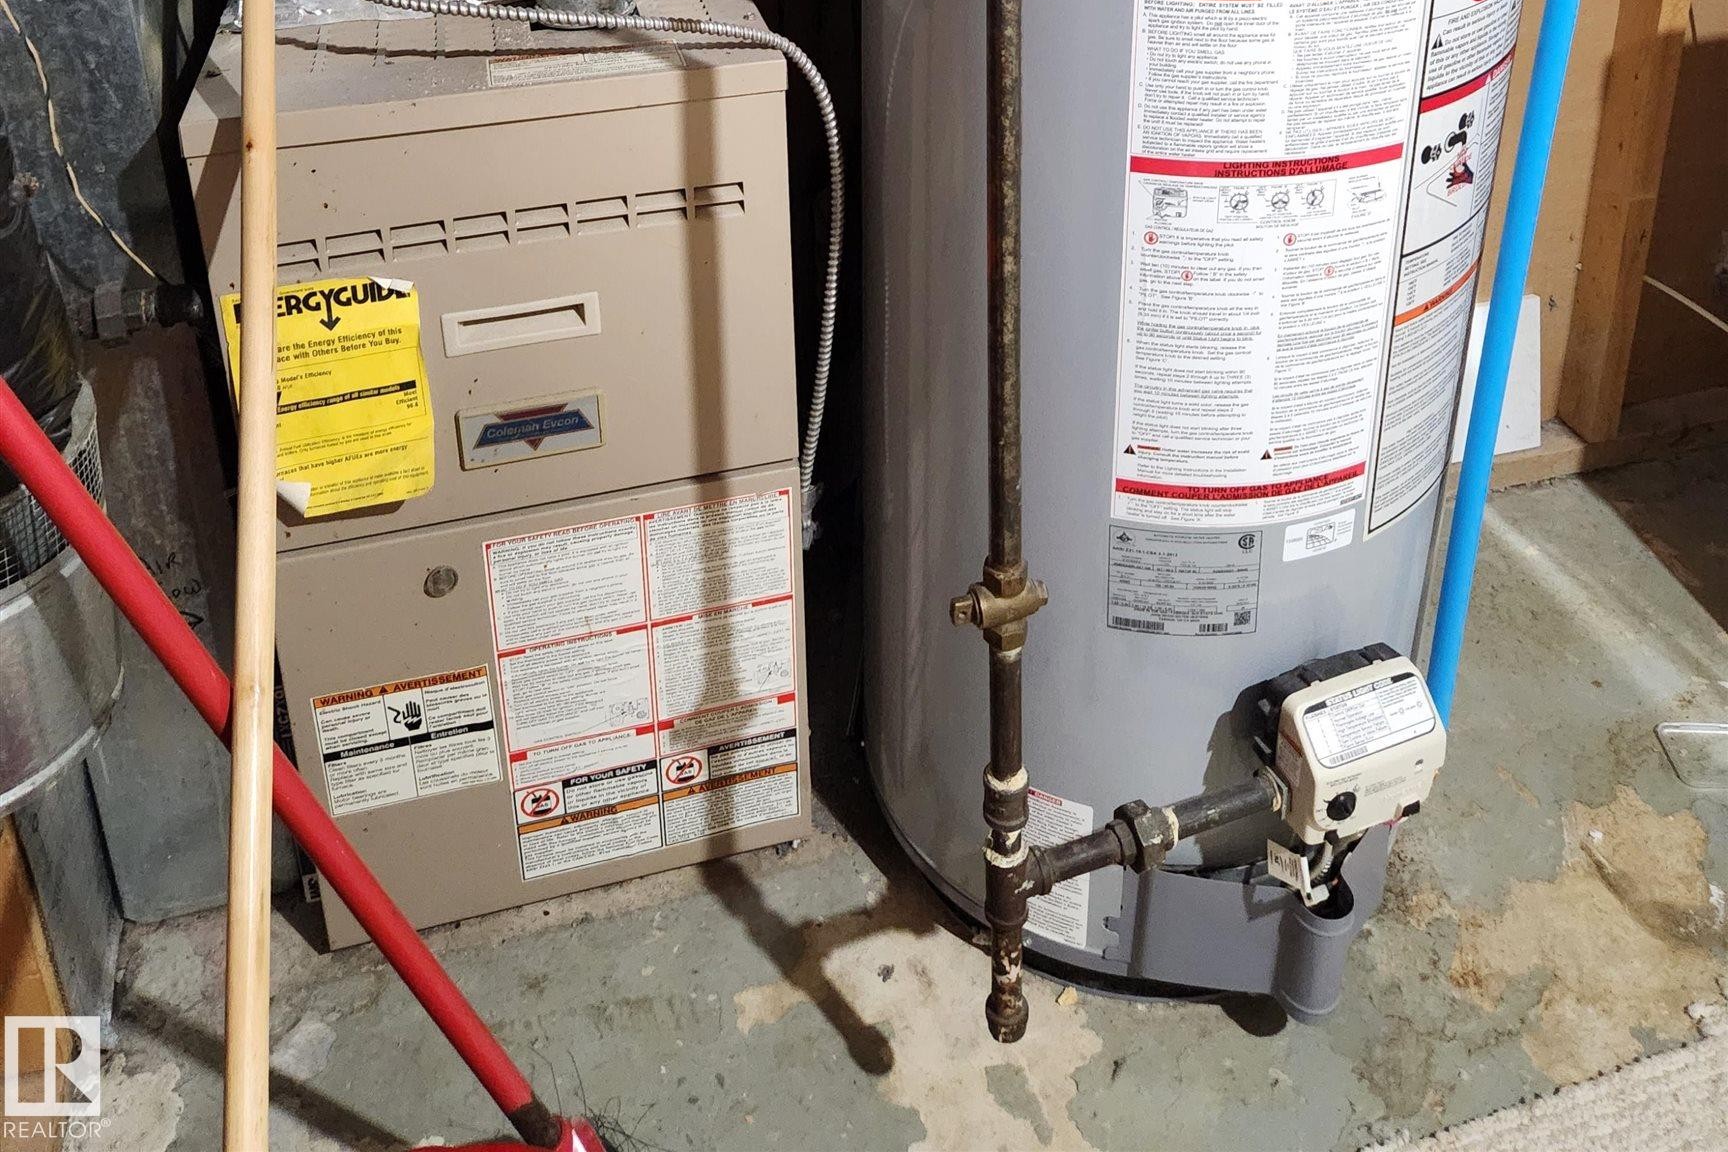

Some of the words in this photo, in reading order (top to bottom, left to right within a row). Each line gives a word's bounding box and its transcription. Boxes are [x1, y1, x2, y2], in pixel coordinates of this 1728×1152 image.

[1214, 169, 1286, 177] INSTRUCTIONS
[1289, 162, 1348, 174] D'ALLUMAGE
[1272, 155, 1340, 167] INSTRUCTIONS
[308, 338, 335, 348] Energy
[338, 331, 376, 343] Efficiency
[387, 327, 402, 335] this
[294, 352, 310, 360] with
[312, 348, 338, 357] Others
[341, 343, 366, 352] Before
[369, 340, 383, 348] You
[385, 337, 401, 345] Buy.
[281, 375, 304, 383] Model's
[305, 370, 332, 379] Efficiency
[277, 404, 297, 413] Energy
[298, 399, 326, 409] efficiency
[327, 396, 343, 404] range
[360, 389, 379, 397] similar
[380, 385, 400, 394] models
[396, 396, 418, 405] Efficient
[486, 422, 540, 439] Coleman
[542, 416, 579, 429] Evcon
[311, 462, 324, 470] have
[326, 458, 344, 467] higher
[390, 444, 408, 453] energy
[1283, 475, 1328, 487] APPLIANCE
[1122, 486, 1169, 498] COMMENT
[1171, 491, 1210, 499] COUPER
[1212, 490, 1268, 500] L'ADMISSION
[1284, 486, 1302, 494] GAZ
[508, 537, 526, 545] YOUR
[528, 532, 551, 541] SAFETY
[572, 525, 597, 533] BEFORE
[599, 518, 635, 528] OPERATING
[529, 640, 565, 652] OPERATING
[566, 632, 613, 645] INSTRUCTIONS
[320, 689, 374, 706] WARNING
[394, 669, 482, 691] AVERTISSEMENT
[431, 728, 468, 739] Entretien
[719, 732, 785, 751] AVERTISSEMENT
[340, 742, 395, 758] Maintenance
[570, 776, 588, 785] FOR
[590, 770, 614, 781] YOUR
[616, 764, 648, 774] SAFETY
[588, 782, 604, 790] store
[628, 771, 653, 781] gasoline
[700, 768, 776, 792] AVERTISSEMENT
[593, 784, 625, 794] flammable
[570, 806, 618, 822] WARNING
